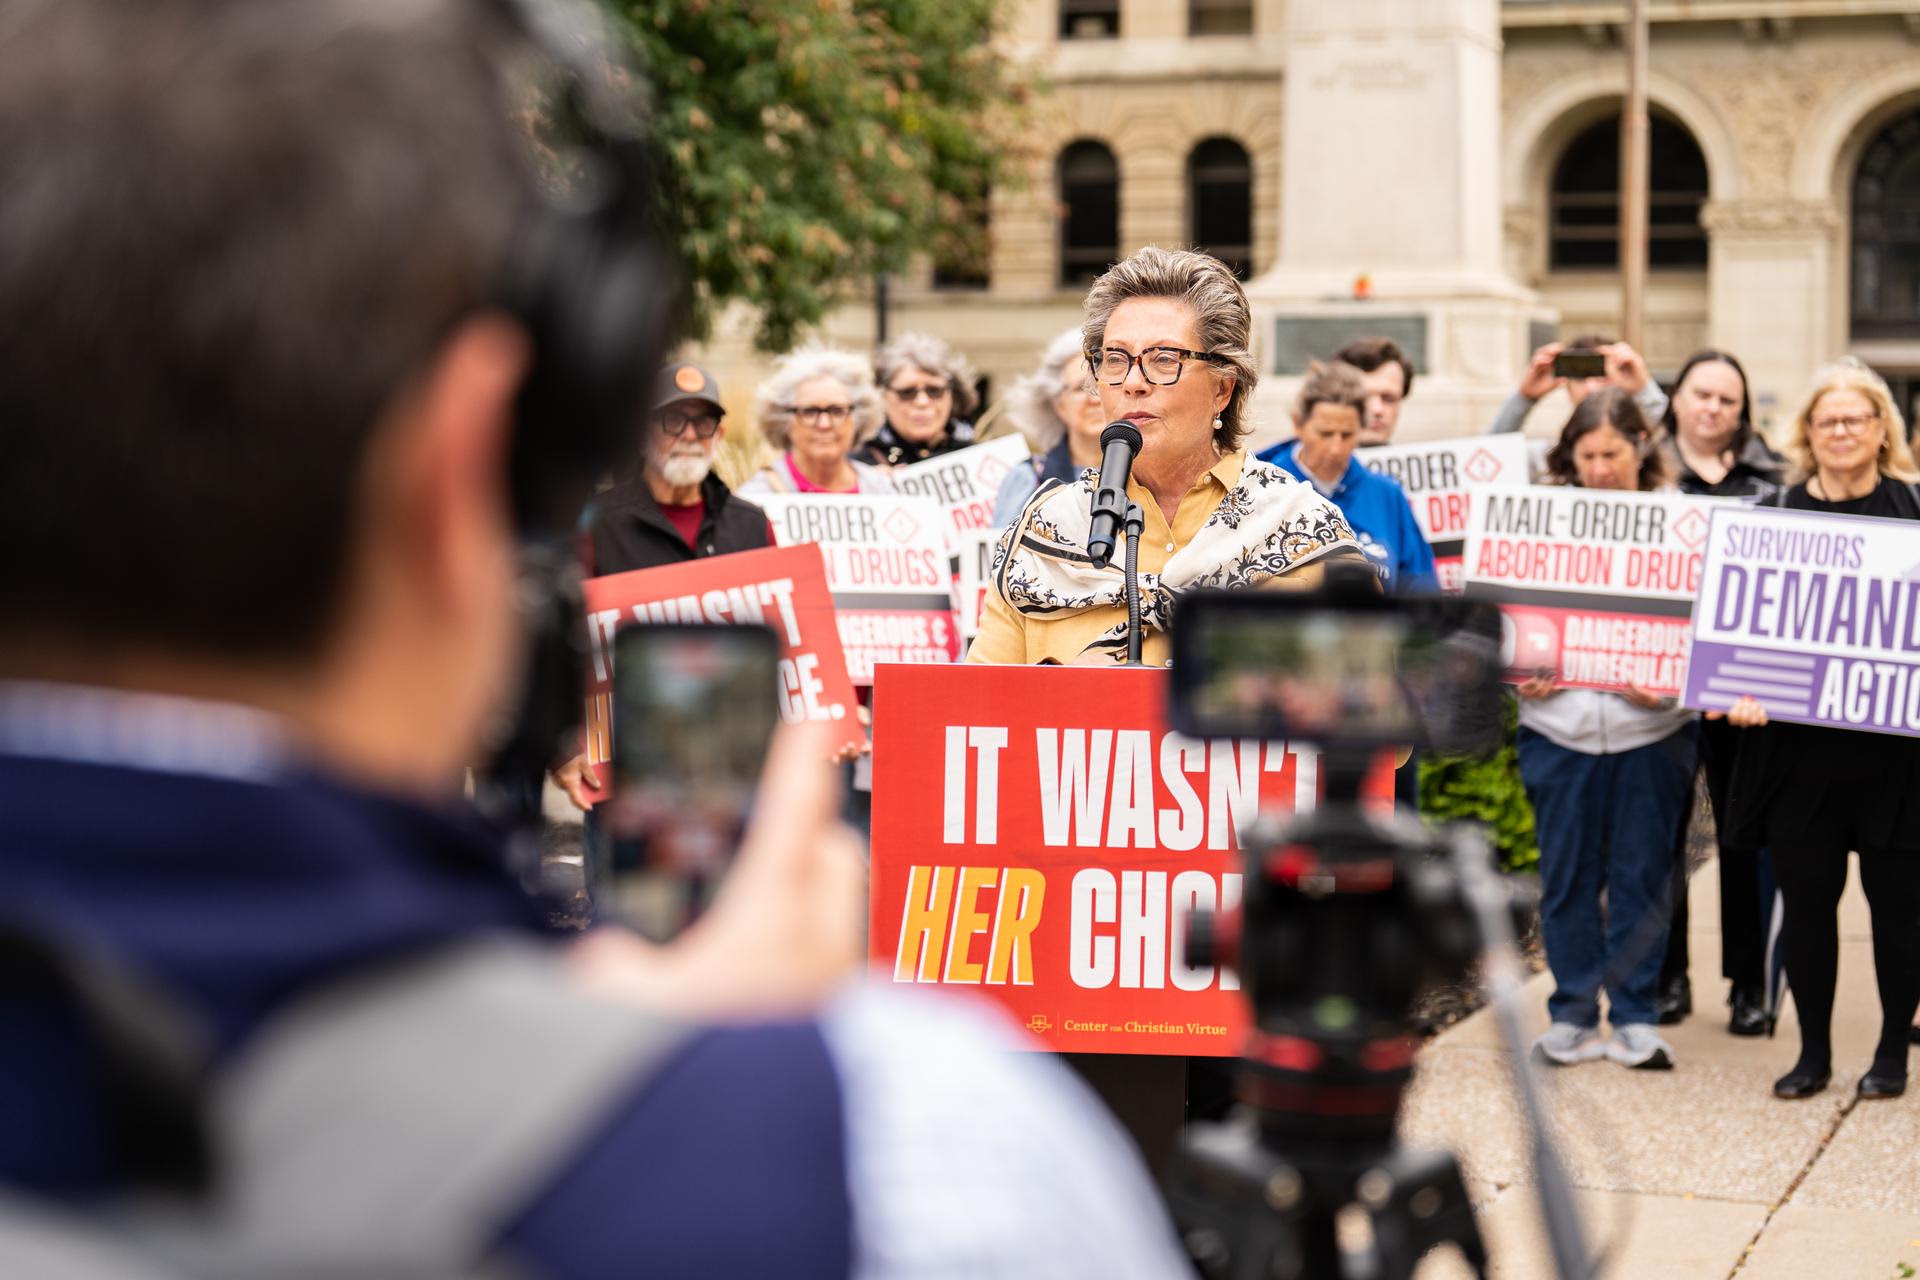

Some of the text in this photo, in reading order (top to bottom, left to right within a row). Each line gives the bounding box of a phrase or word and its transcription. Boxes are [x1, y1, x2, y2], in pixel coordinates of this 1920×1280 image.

[1485, 495, 1667, 545] MAIL-ORDER
[849, 547, 939, 587] DRUGS
[1476, 538, 1613, 586] ABORTION
[1626, 548, 1701, 593] DRUG
[1724, 523, 1865, 570] SURVIVORS
[1713, 563, 1920, 652] DEMAND
[943, 725, 1321, 851] IT WASN'T
[893, 865, 1047, 986] HER
[1064, 1019, 1108, 1032] Center
[1124, 1021, 1184, 1035] Christian
[1186, 1022, 1228, 1036] Virtue
